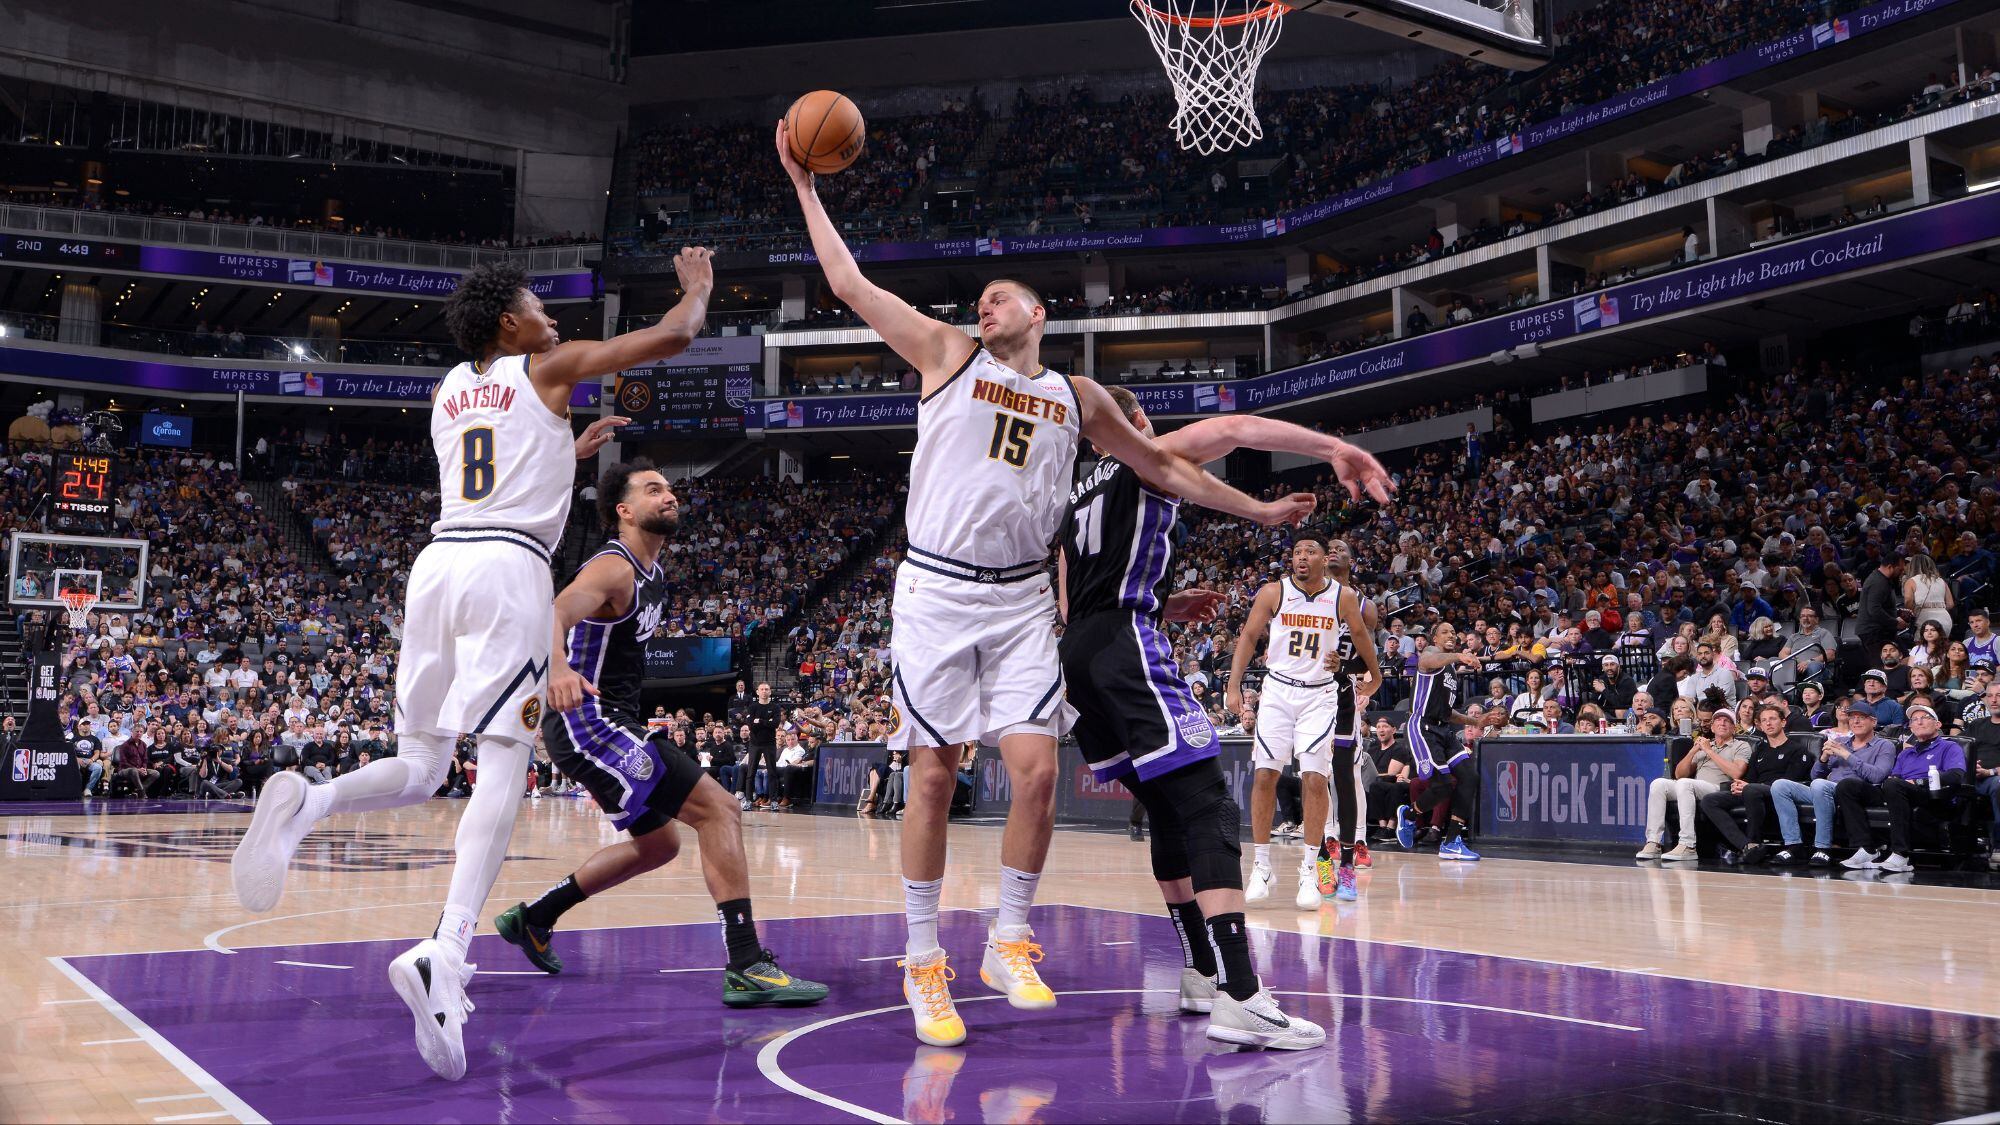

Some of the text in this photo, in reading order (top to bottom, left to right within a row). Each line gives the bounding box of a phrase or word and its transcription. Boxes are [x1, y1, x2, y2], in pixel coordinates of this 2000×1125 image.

[1860, 11, 1879, 28] Try
[1882, 5, 1900, 20] the
[1758, 34, 1805, 57] EMPRESS
[1770, 47, 1794, 62] 1908
[1530, 86, 1669, 144] Try the Light the Beam Cocktail
[1457, 145, 1492, 162] EMPRESS
[16, 240, 116, 256] 2ND 4:49 24
[934, 241, 971, 250] EMPRESS
[1010, 234, 1143, 251] Try the Light the Beam Cocktail
[219, 255, 279, 269] EMPRESS
[768, 254, 788, 263] 8:00
[789, 252, 802, 262] PM
[233, 268, 263, 278] 1908
[346, 269, 370, 286] Try
[373, 273, 395, 287] the
[398, 275, 434, 291] Light
[1631, 233, 1883, 312] Try the Light the Beam Cocktail
[1510, 309, 1565, 332] EMPRESS
[1523, 326, 1552, 342] 1908
[212, 370, 270, 382] EMPRESS
[621, 368, 653, 377] NUGGETS
[667, 367, 686, 375] GAME
[1246, 352, 1404, 404] Try the Light the Beam Cocktail
[226, 381, 256, 391] 1908
[336, 378, 359, 394] Try
[362, 380, 383, 393] the
[387, 381, 422, 396] Light
[1135, 389, 1184, 400] MPRESS
[443, 383, 516, 421] WATSON
[658, 392, 669, 400] 24
[705, 390, 715, 398] 22
[972, 378, 1067, 426] NUGGETS
[707, 402, 713, 410] 7
[814, 403, 915, 422] Try the Light the
[152, 425, 181, 437] Corona
[987, 411, 1037, 470] 15
[73, 457, 109, 474] 4:49
[461, 425, 496, 503] 8
[63, 471, 103, 500] 24
[70, 503, 109, 513] TISSOT
[1280, 612, 1335, 631] NUGGETS
[1288, 630, 1321, 660] 24
[40, 665, 55, 677] GET
[40, 676, 54, 688] THE
[43, 688, 57, 701] App
[1180, 723, 1209, 737] KINGS
[32, 750, 69, 767] League
[31, 765, 57, 781] Pass
[831, 757, 872, 795] Pick'E
[1522, 762, 1647, 826] Pick'Em
